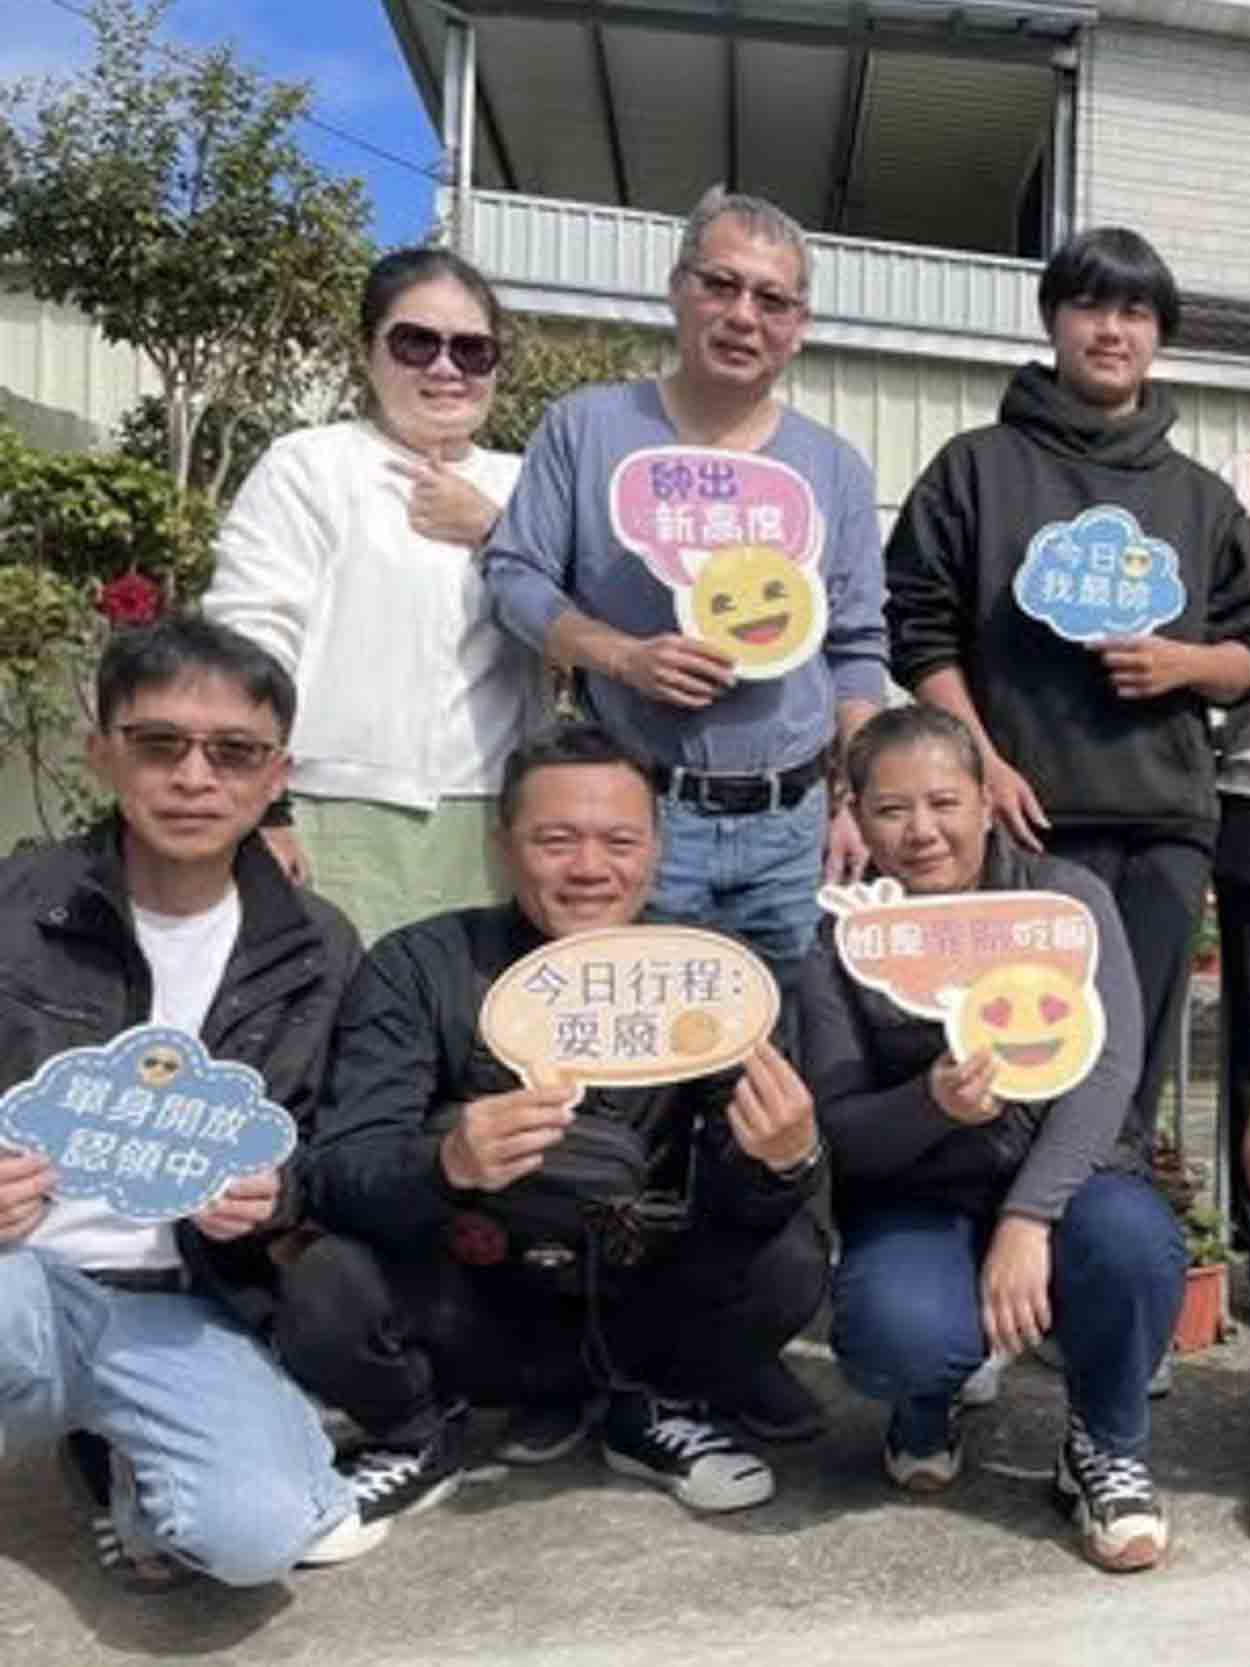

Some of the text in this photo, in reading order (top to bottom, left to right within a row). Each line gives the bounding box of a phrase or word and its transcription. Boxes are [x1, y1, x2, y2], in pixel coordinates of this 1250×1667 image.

[651, 462, 738, 499] 帥出
[652, 502, 784, 544] 新高度
[1042, 542, 1115, 573] 今日
[554, 1010, 661, 1058] 耍廢
[62, 1074, 249, 1145] 單身開放
[60, 1128, 210, 1186] 認領中
